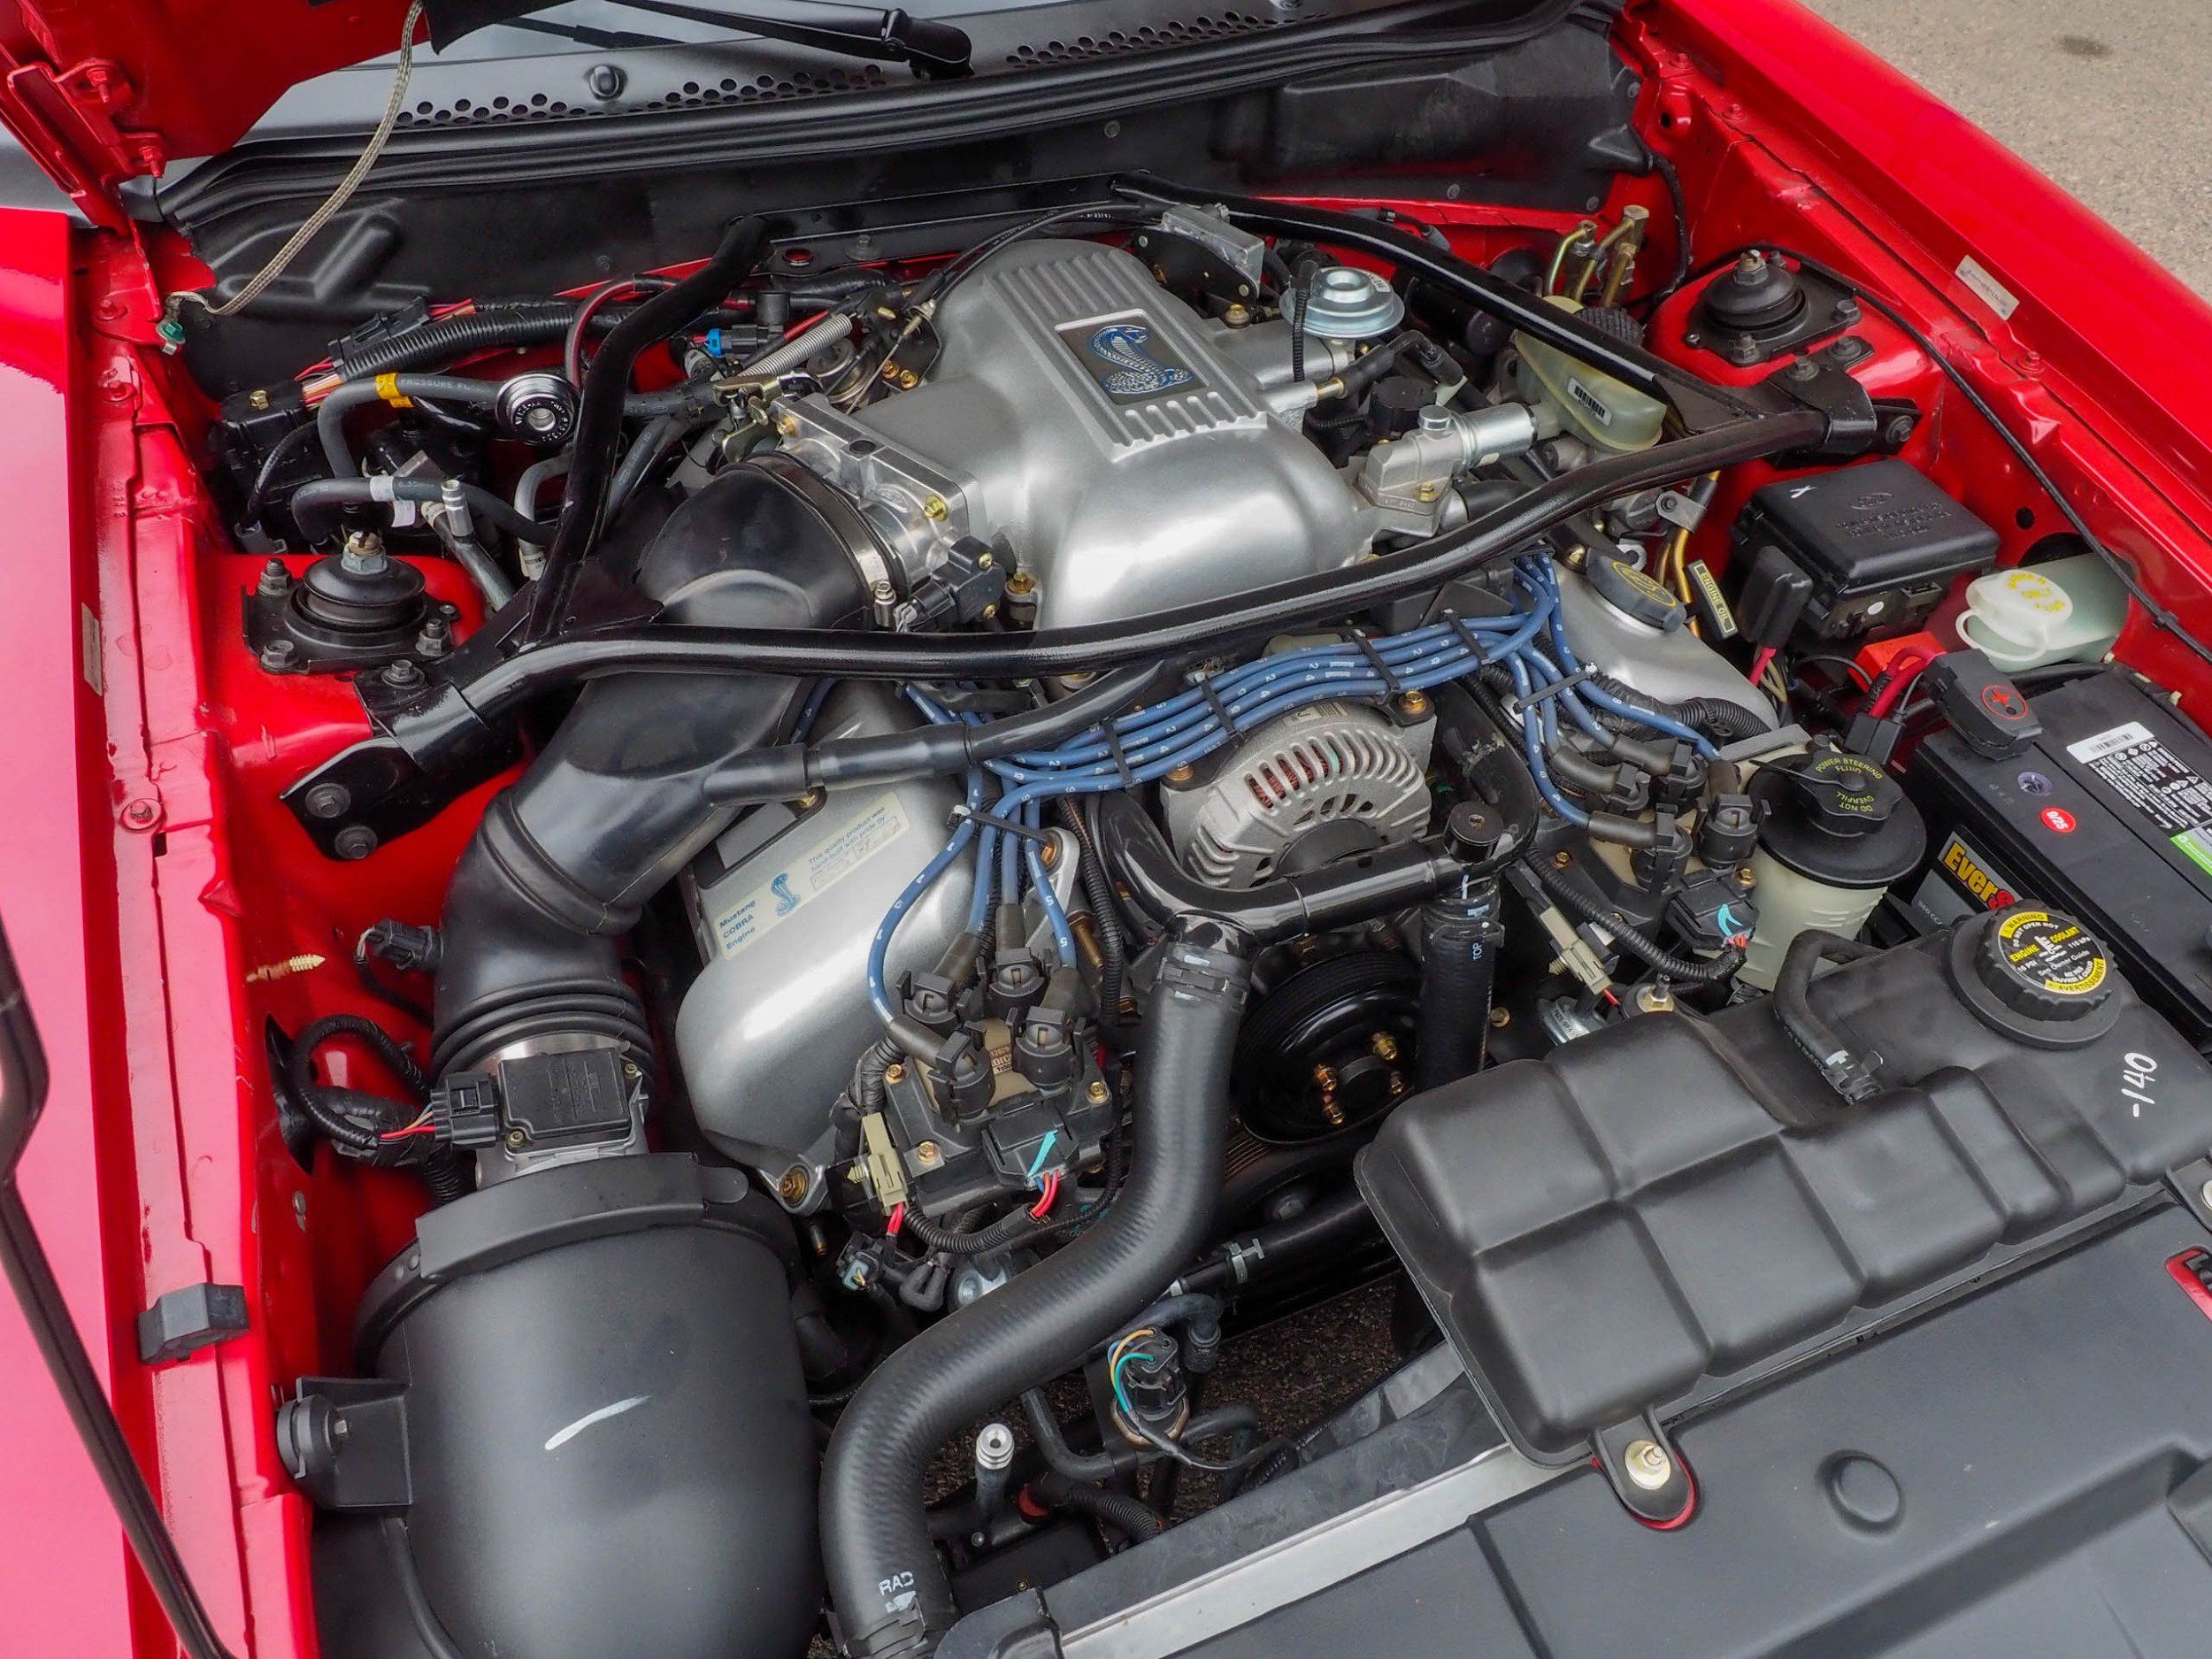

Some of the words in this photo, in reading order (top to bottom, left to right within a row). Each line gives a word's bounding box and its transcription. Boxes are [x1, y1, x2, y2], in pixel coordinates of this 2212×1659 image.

[1699, 572, 1721, 606] ENGINE
[1717, 605, 1730, 625] OIL
[1815, 757, 1841, 773] POWER
[1842, 757, 1884, 780] STEERING
[1837, 791, 1875, 804] OVERFILL
[1839, 802, 1859, 811] NOT
[2046, 810, 2070, 830] 9/25
[718, 900, 756, 929] Mustang
[2008, 913, 2046, 929] WARNING
[723, 914, 754, 940] COBRA
[726, 927, 756, 950] Engine
[1472, 941, 1483, 961] TOP
[2010, 943, 2040, 963] ENGINE
[2051, 926, 2080, 944] COOLANT
[2038, 967, 2053, 977] See
[2050, 958, 2072, 971] Owner
[2070, 949, 2091, 961] Guide
[2058, 962, 2103, 990] AVERTISSEMENT
[878, 1571, 914, 1596] RAD
